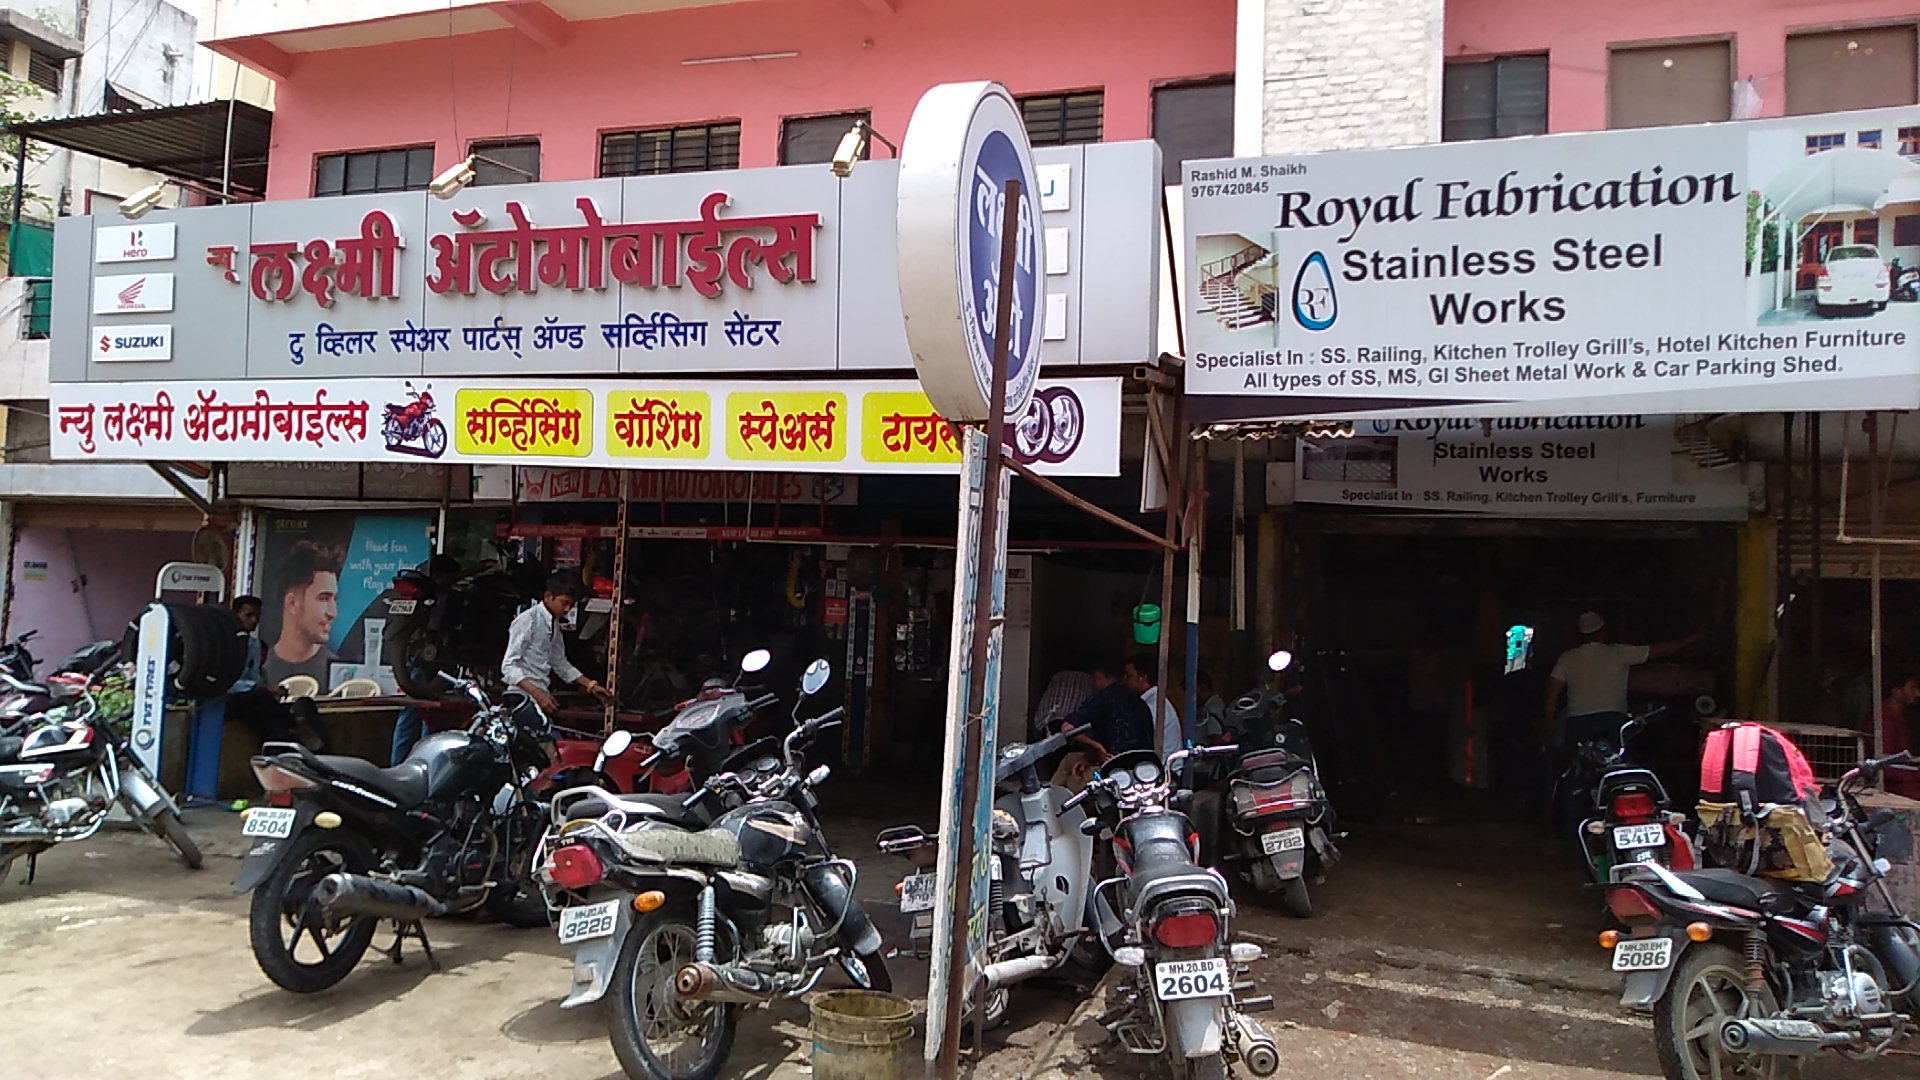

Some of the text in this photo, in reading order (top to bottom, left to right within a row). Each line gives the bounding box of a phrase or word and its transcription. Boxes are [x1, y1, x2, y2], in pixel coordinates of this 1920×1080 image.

[1191, 163, 1307, 182] Rashid M. Shaikh
[1191, 181, 1269, 198] 9767420845
[1275, 164, 1741, 243] Royal Fabrication
[250, 209, 406, 308] लक्ष्मी
[1342, 233, 1663, 282] Stainless Steel
[1430, 290, 1567, 326] Works
[115, 335, 164, 349] SUZUKI
[289, 333, 305, 365] टु
[316, 322, 378, 357] व्हिलर
[389, 320, 451, 353] स्पेअर
[724, 309, 782, 347] सेंटर
[1195, 350, 1282, 372] Specialist
[1287, 349, 1304, 365] In
[1357, 346, 1427, 366] Railing,
[1433, 341, 1507, 361] Kitchen
[1513, 339, 1579, 361] Trolley
[1657, 334, 1710, 354] Hotel
[1717, 331, 1798, 352] Kitchen
[1805, 328, 1906, 349] Furniture
[1243, 354, 1844, 391] All types of SS, MS, GI Sheet Metal Work & Car Parking Shed.
[103, 390, 175, 447] लक्ष्मी
[466, 398, 582, 451] सर्व्हिसिंग
[614, 398, 703, 451] वॉशिंग
[738, 400, 837, 453] स्पेअर्स
[1433, 441, 1596, 460] Stainless Steel
[553, 470, 579, 496] NEW
[1478, 465, 1549, 483] Works
[1341, 489, 1398, 502] Specialist
[1495, 491, 1543, 503] Kitchen
[1546, 491, 1589, 506] Trolley
[1636, 492, 1696, 504] Furniture
[374, 562, 395, 576] your
[247, 818, 288, 835] 8504
[1618, 831, 1661, 846] 5417
[1265, 835, 1303, 853] 2782
[565, 915, 613, 939] 3228
[1617, 951, 1667, 968] 5086
[1162, 972, 1225, 996] 2604
